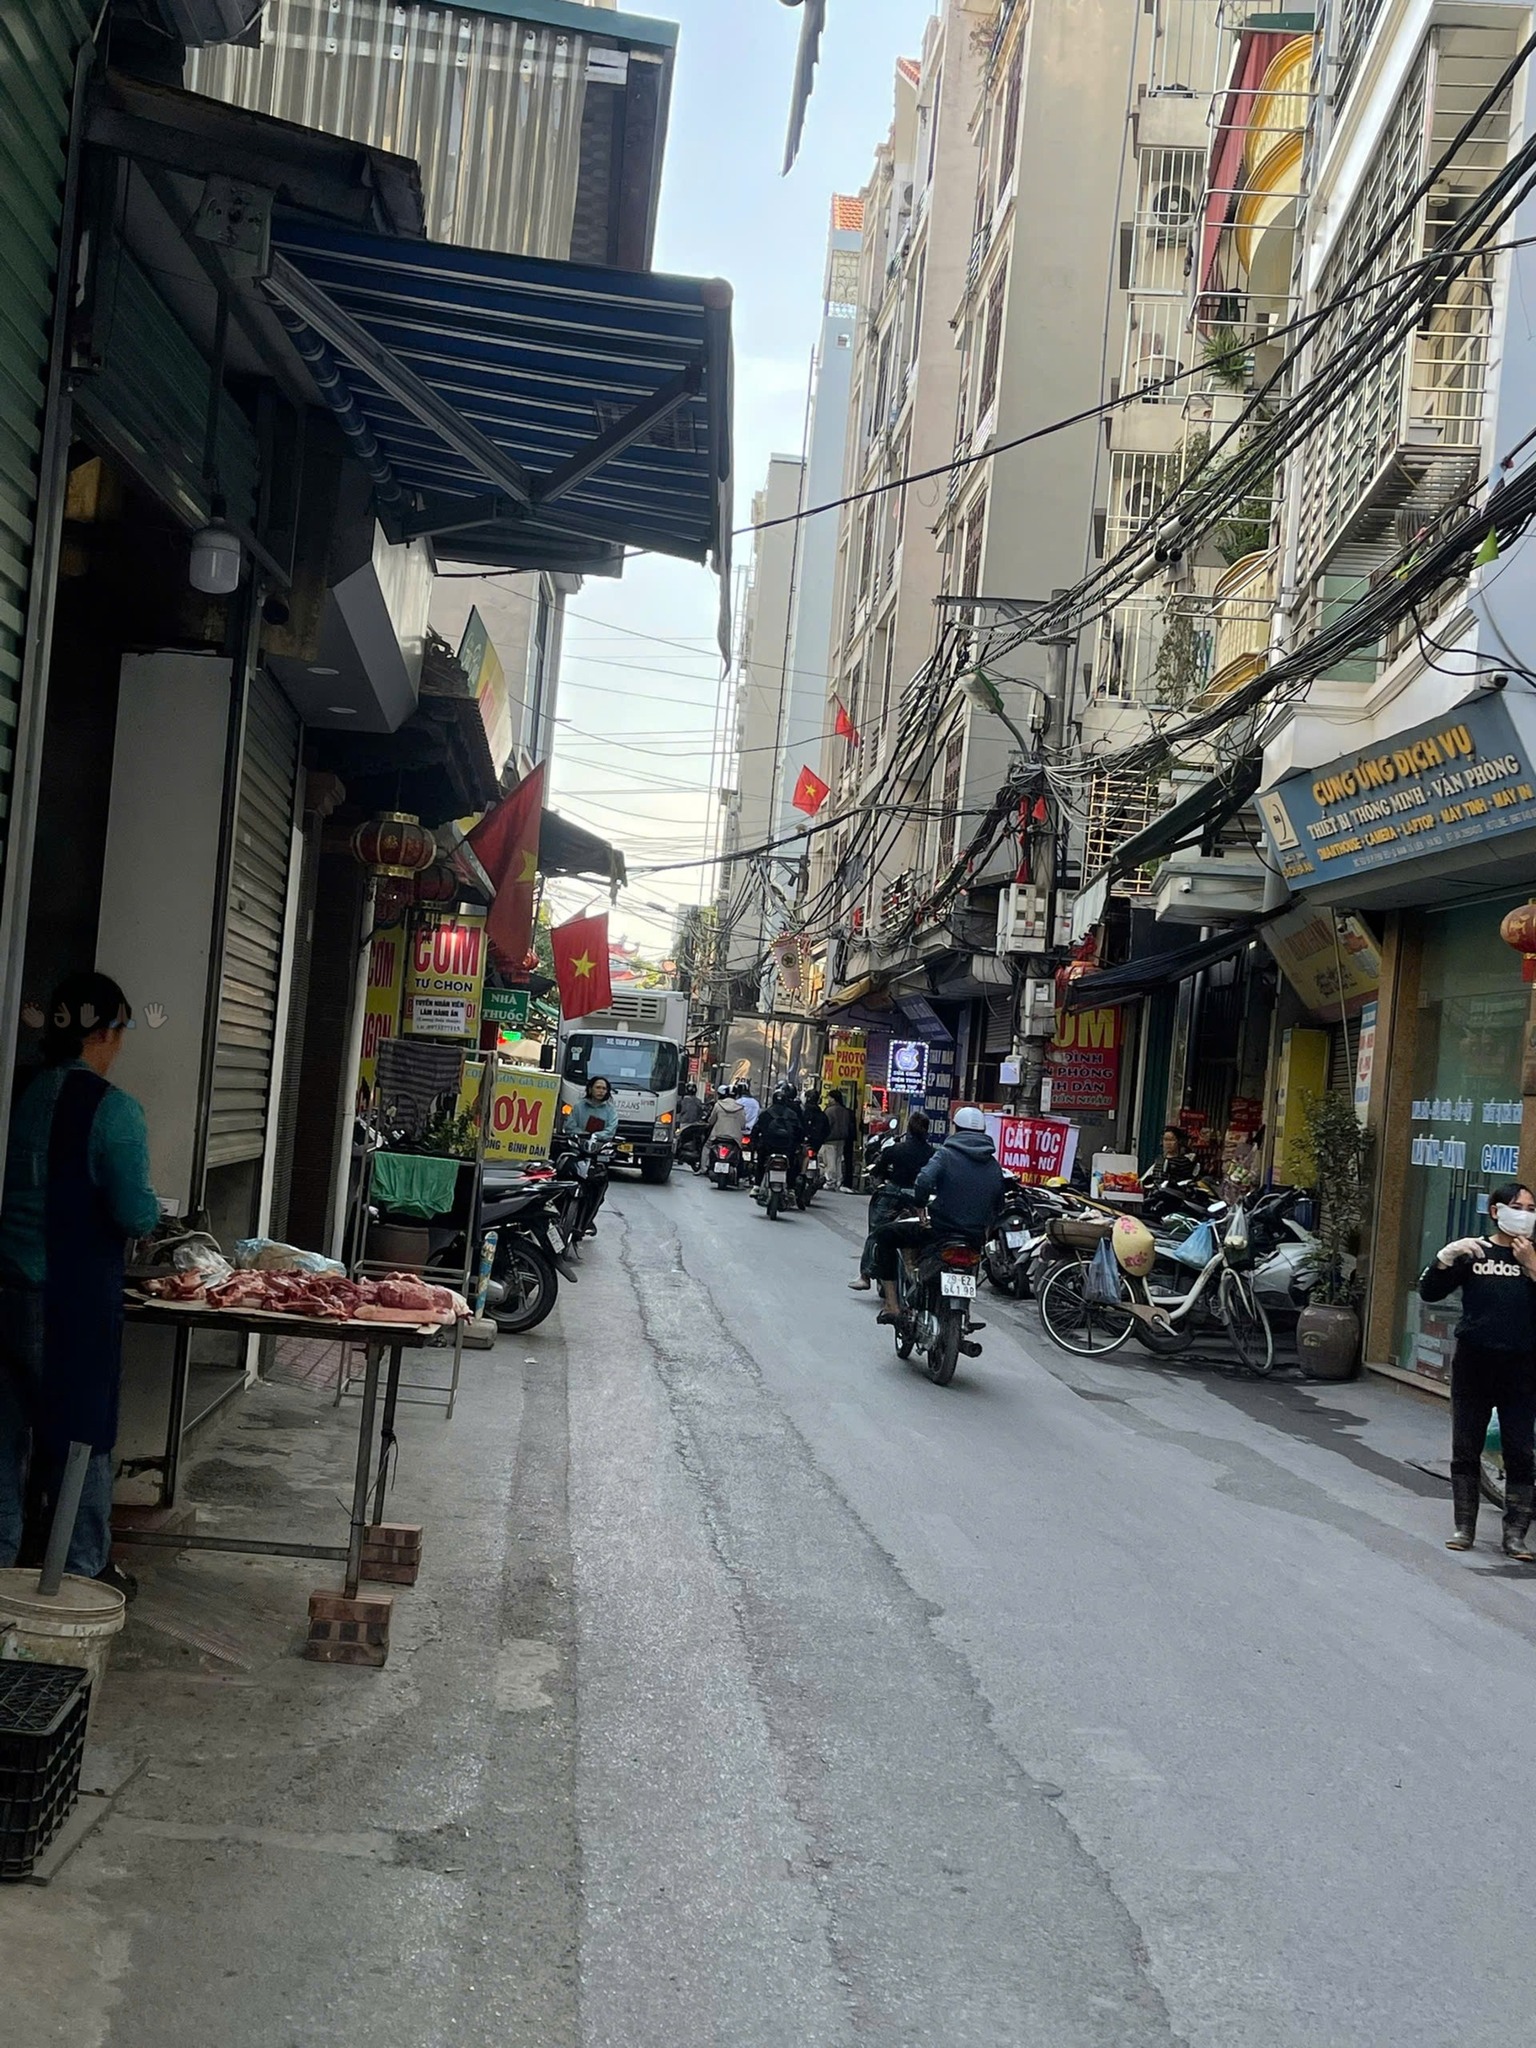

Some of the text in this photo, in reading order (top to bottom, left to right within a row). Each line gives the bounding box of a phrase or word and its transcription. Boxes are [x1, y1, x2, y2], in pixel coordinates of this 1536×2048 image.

[1312, 725, 1474, 806] CUNG ỨNG DỊCH VỤ
[1307, 755, 1520, 840] THIẾT BỊ THÔNG MINH VĂN PHÒNG
[1364, 826, 1398, 847] CAMERA
[1401, 814, 1435, 836] LAPTOP
[414, 920, 481, 977] CƠM
[415, 978, 473, 994] TỰ CHỌN
[491, 993, 517, 1005] NHÀ
[483, 1008, 524, 1021] THUỐC
[836, 1050, 865, 1065] PHOTO
[838, 1065, 863, 1078] COPY
[1057, 1065, 1114, 1079] PHÒNG
[1072, 1080, 1105, 1093] DÂN
[1005, 1121, 1061, 1154] CẮT TÓC
[508, 1141, 528, 1154] BÌNH
[1003, 1151, 1030, 1168] NAM
[1038, 1155, 1057, 1171] NỮ
[1472, 1259, 1521, 1276] adidas
